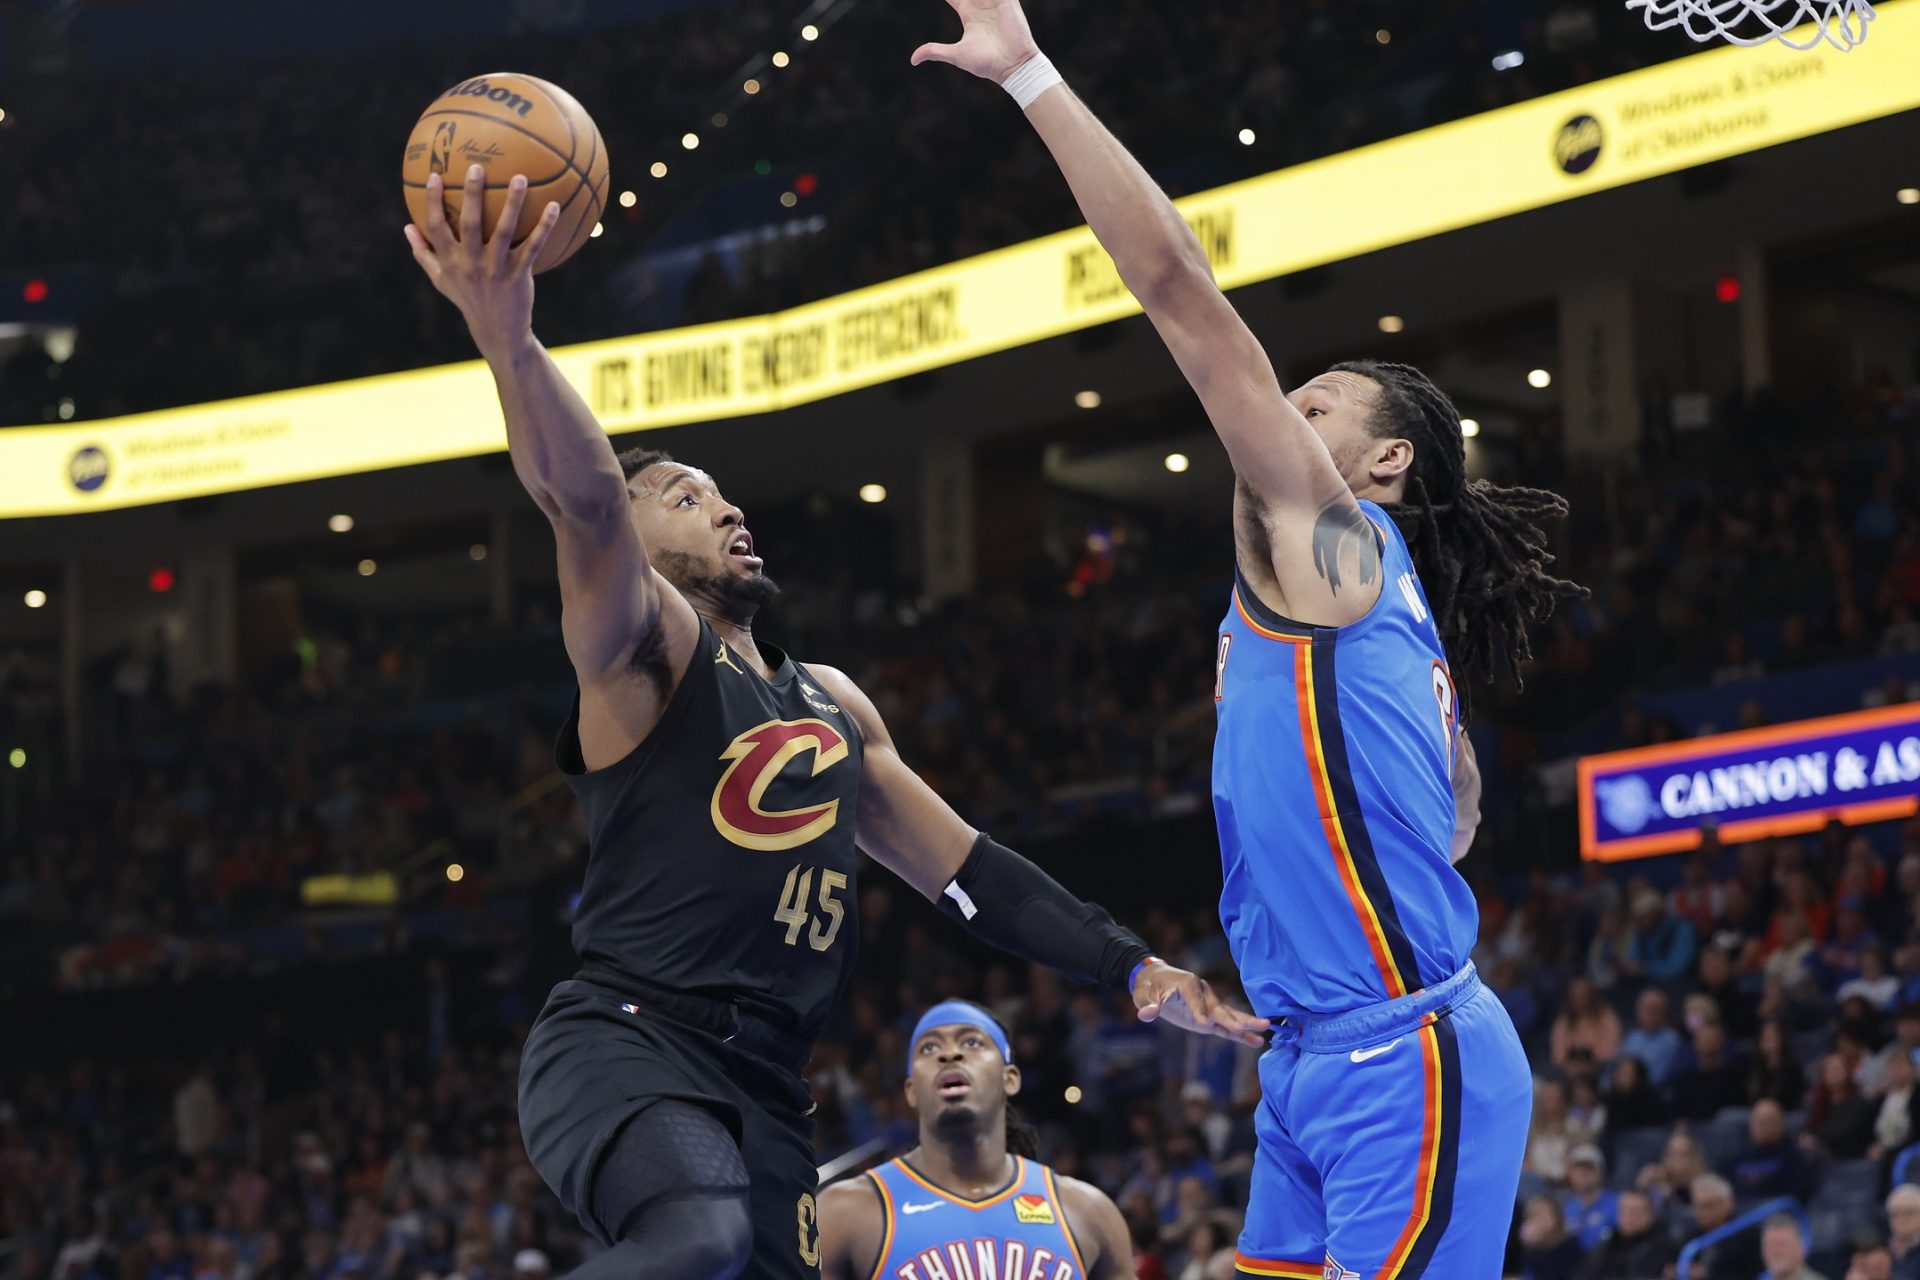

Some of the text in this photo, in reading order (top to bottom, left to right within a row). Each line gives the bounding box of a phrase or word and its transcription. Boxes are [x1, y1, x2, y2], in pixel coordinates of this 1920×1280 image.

[442, 79, 533, 117] ilson
[643, 342, 732, 407] GIVING
[741, 325, 828, 392] ENERGY
[1660, 750, 1829, 818] CANNON
[1832, 746, 1869, 792] &
[773, 863, 848, 951] 45
